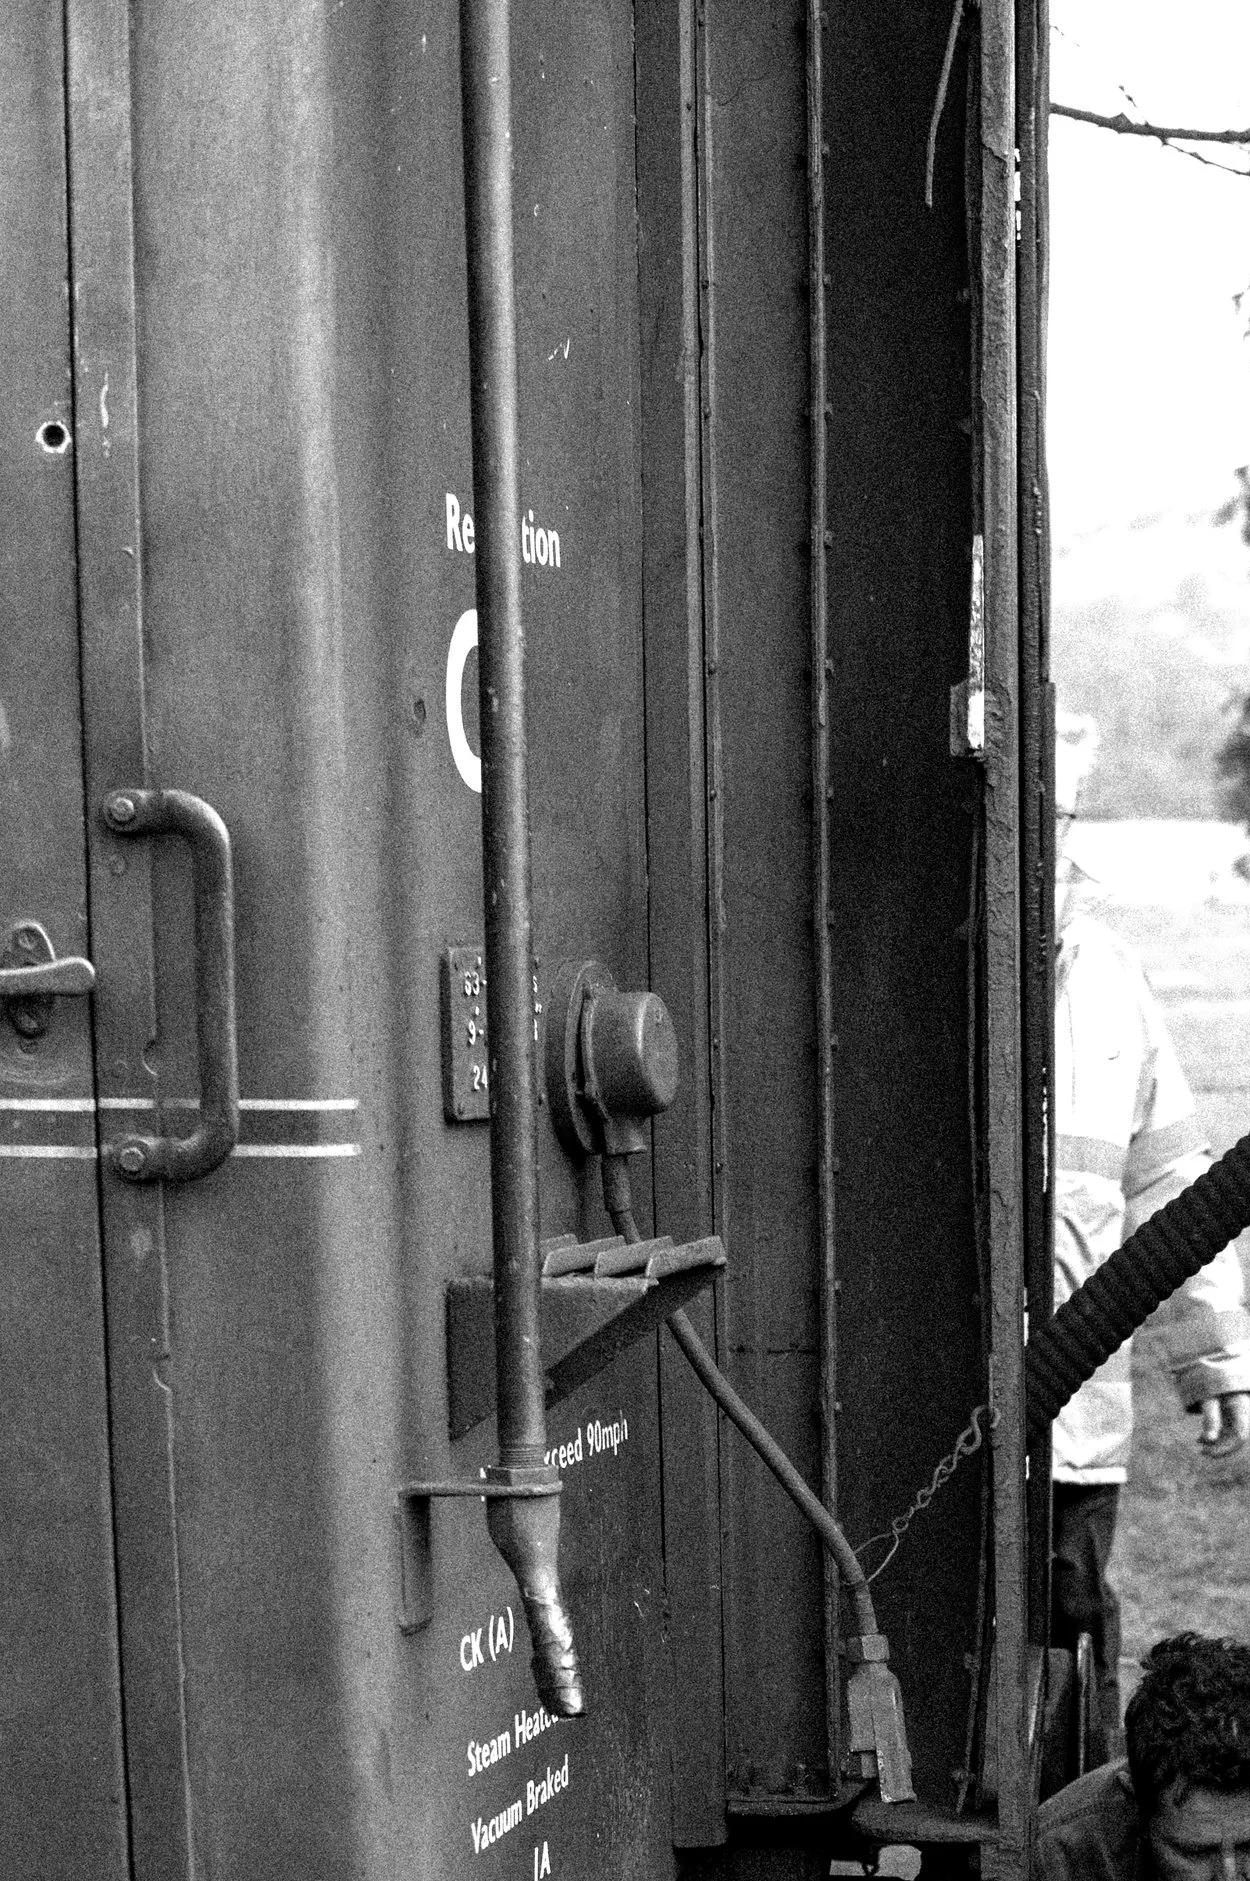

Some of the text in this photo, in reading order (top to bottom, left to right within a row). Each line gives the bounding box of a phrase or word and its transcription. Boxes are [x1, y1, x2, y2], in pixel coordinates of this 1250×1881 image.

[446, 493, 561, 568] Retion
[587, 1409, 628, 1456] 90mph
[460, 1606, 515, 1671] CK (A)
[467, 1706, 559, 1777] Steam Heate
[471, 1753, 569, 1854] Vacuum Braked
